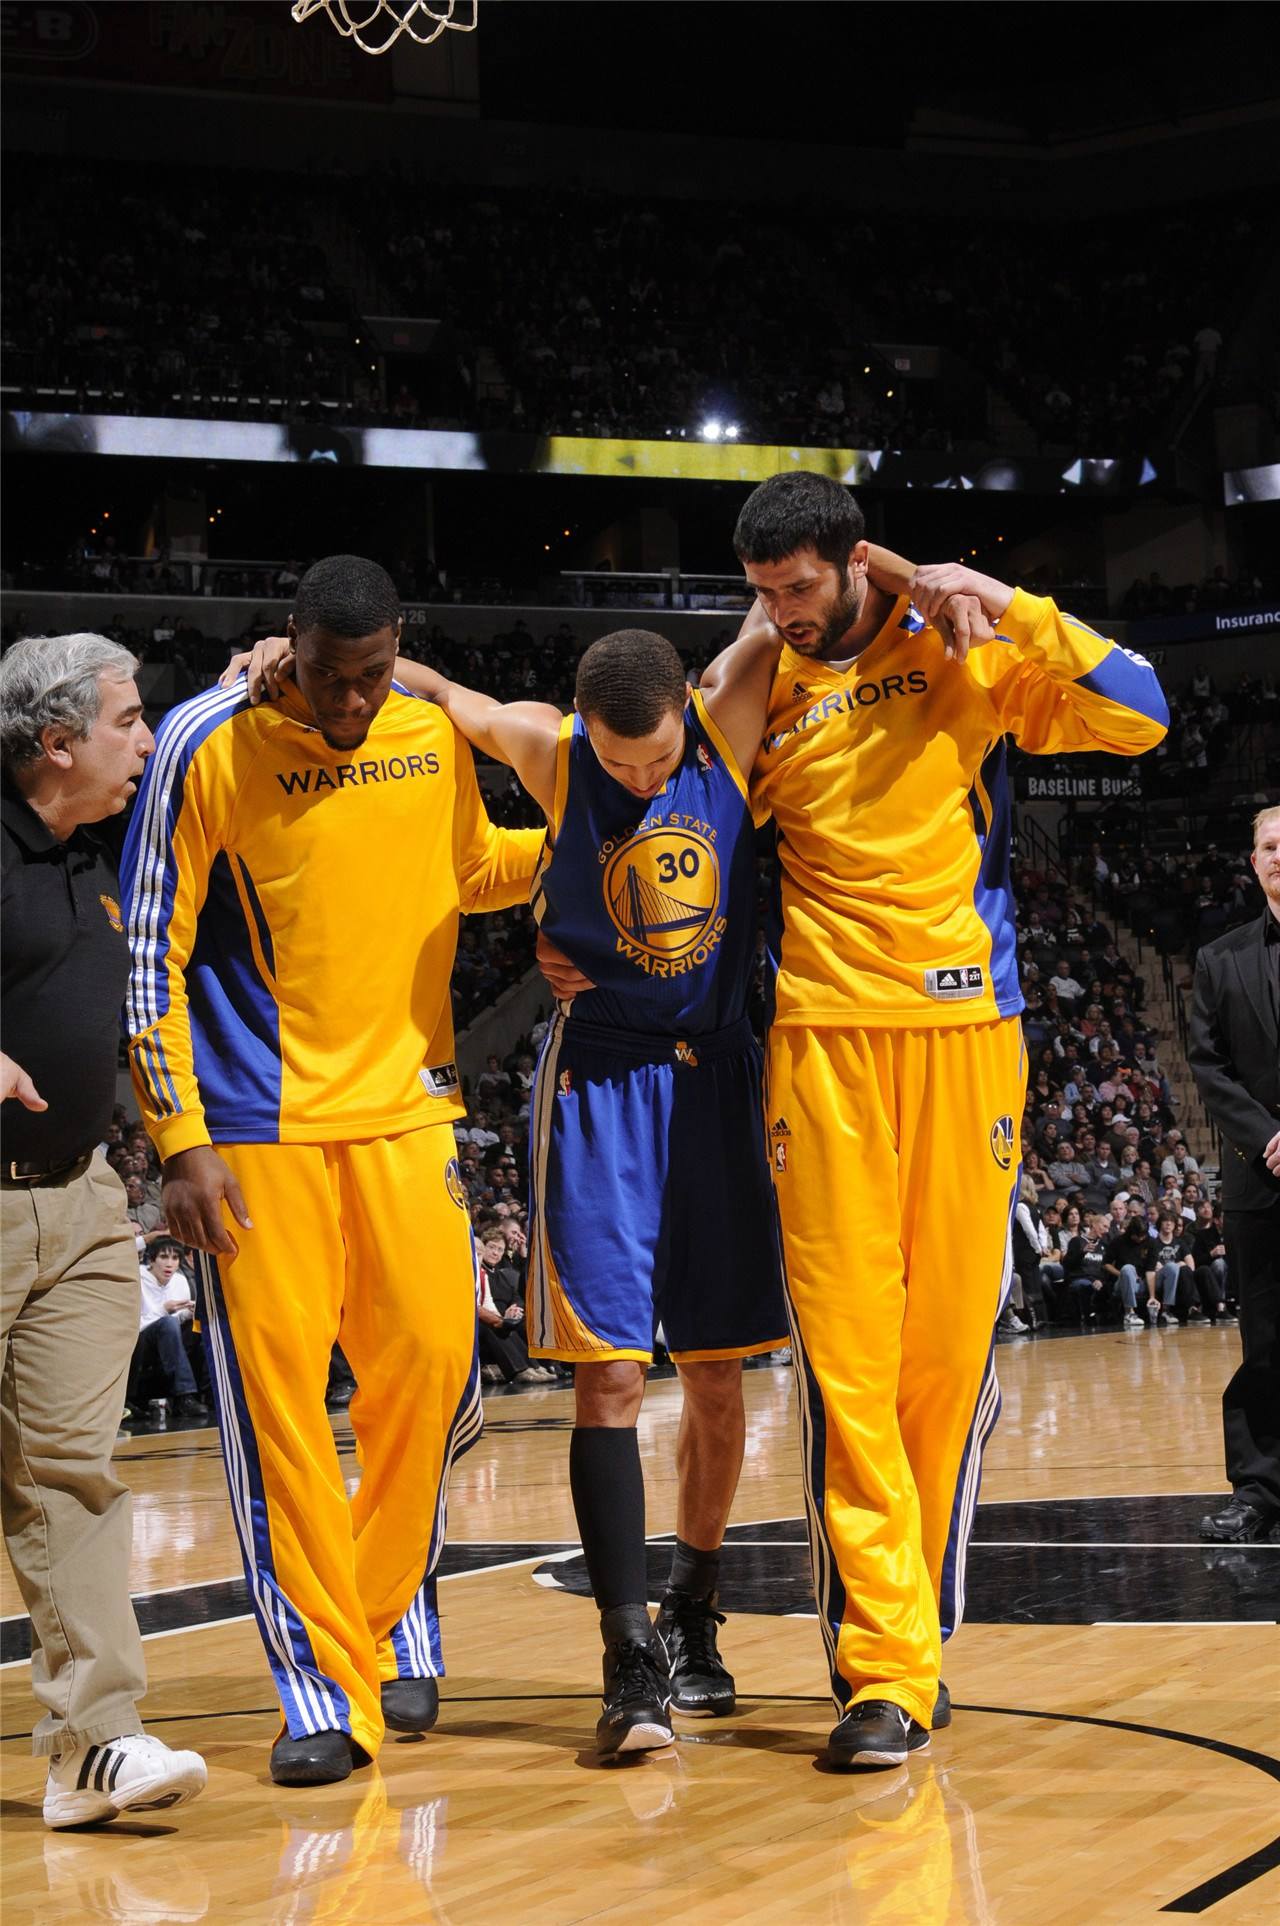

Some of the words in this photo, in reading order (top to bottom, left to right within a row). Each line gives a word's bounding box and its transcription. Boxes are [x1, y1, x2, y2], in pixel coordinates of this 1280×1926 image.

[276, 752, 440, 796] WARRIORS
[1027, 776, 1097, 796] BASELINE
[598, 815, 663, 864] GOLDEN
[669, 812, 718, 843] STATE
[656, 848, 700, 883] 30
[615, 916, 729, 979] WARRIORS
